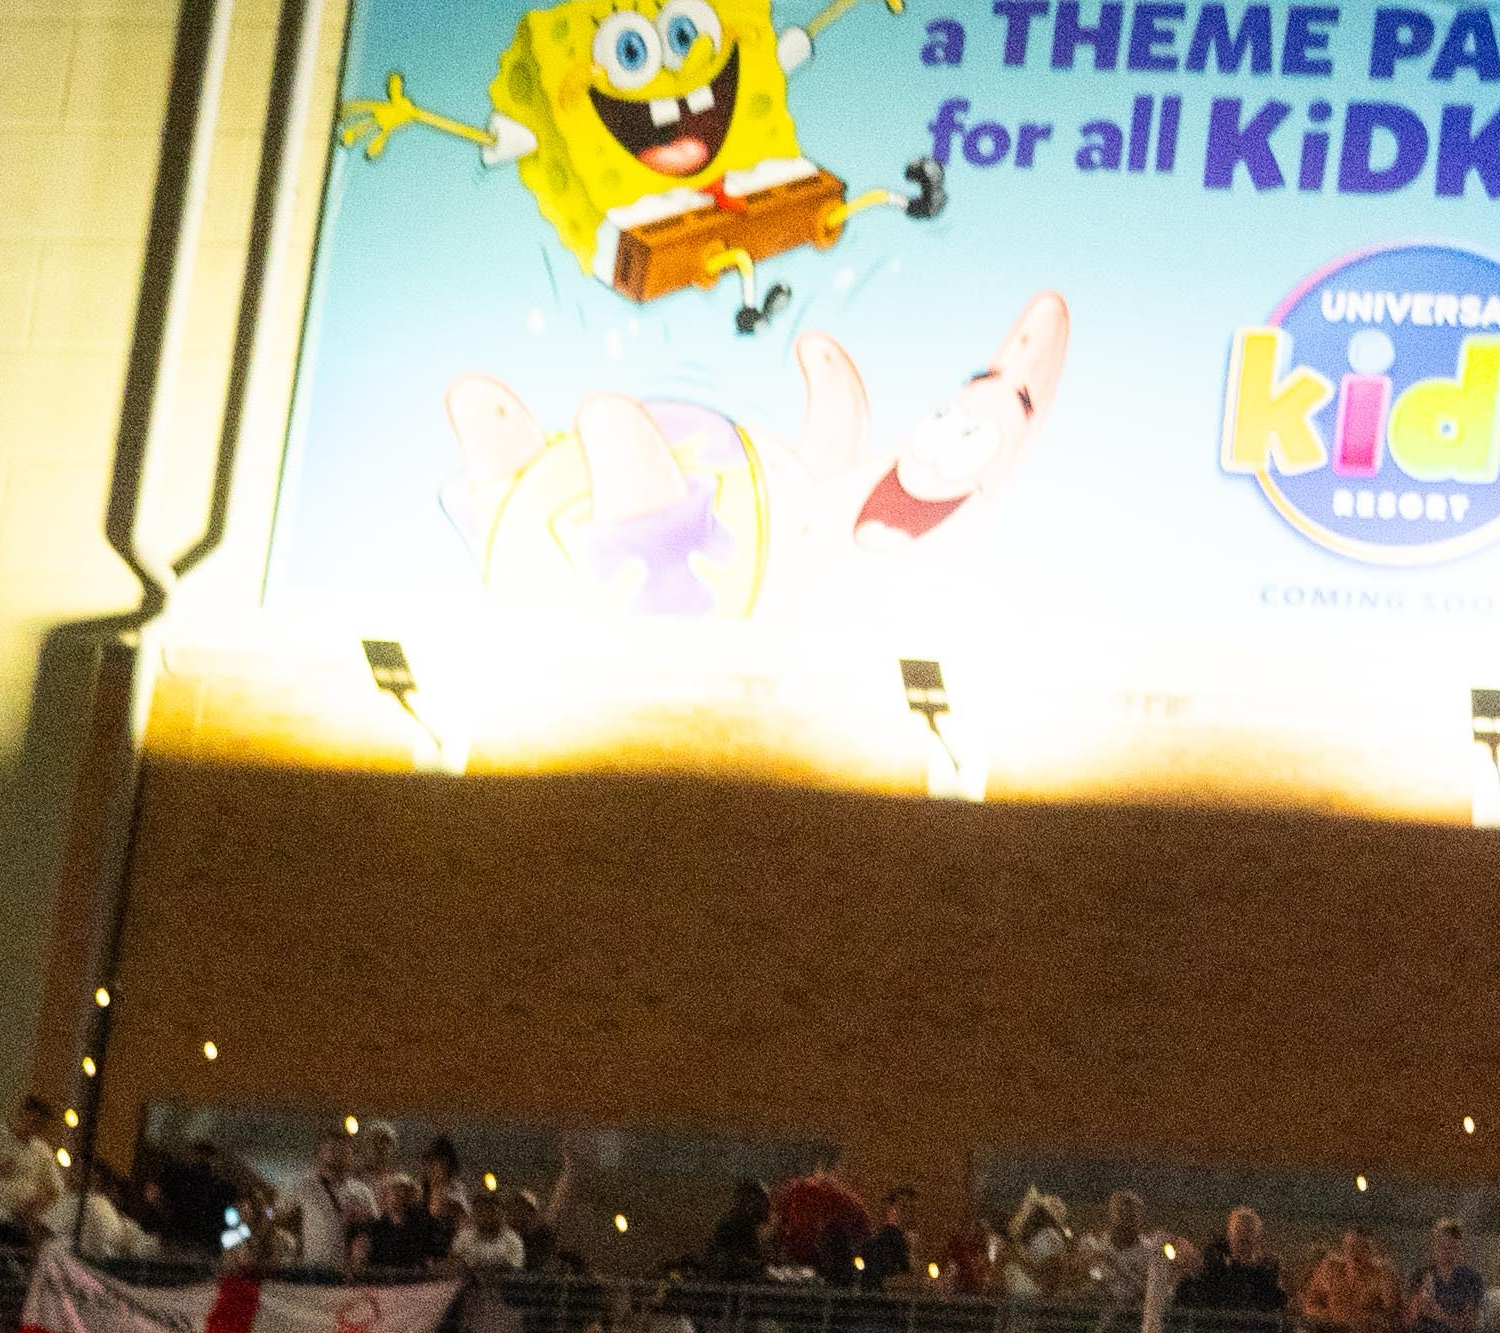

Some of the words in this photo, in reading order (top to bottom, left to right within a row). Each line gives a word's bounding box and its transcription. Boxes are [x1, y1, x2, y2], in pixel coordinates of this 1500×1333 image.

[921, 20, 965, 65] a
[992, 0, 1336, 76] THEME
[928, 99, 1053, 168] for
[1075, 96, 1182, 172] all
[1332, 488, 1470, 523] RESORT
[1258, 584, 1404, 611] COMING
